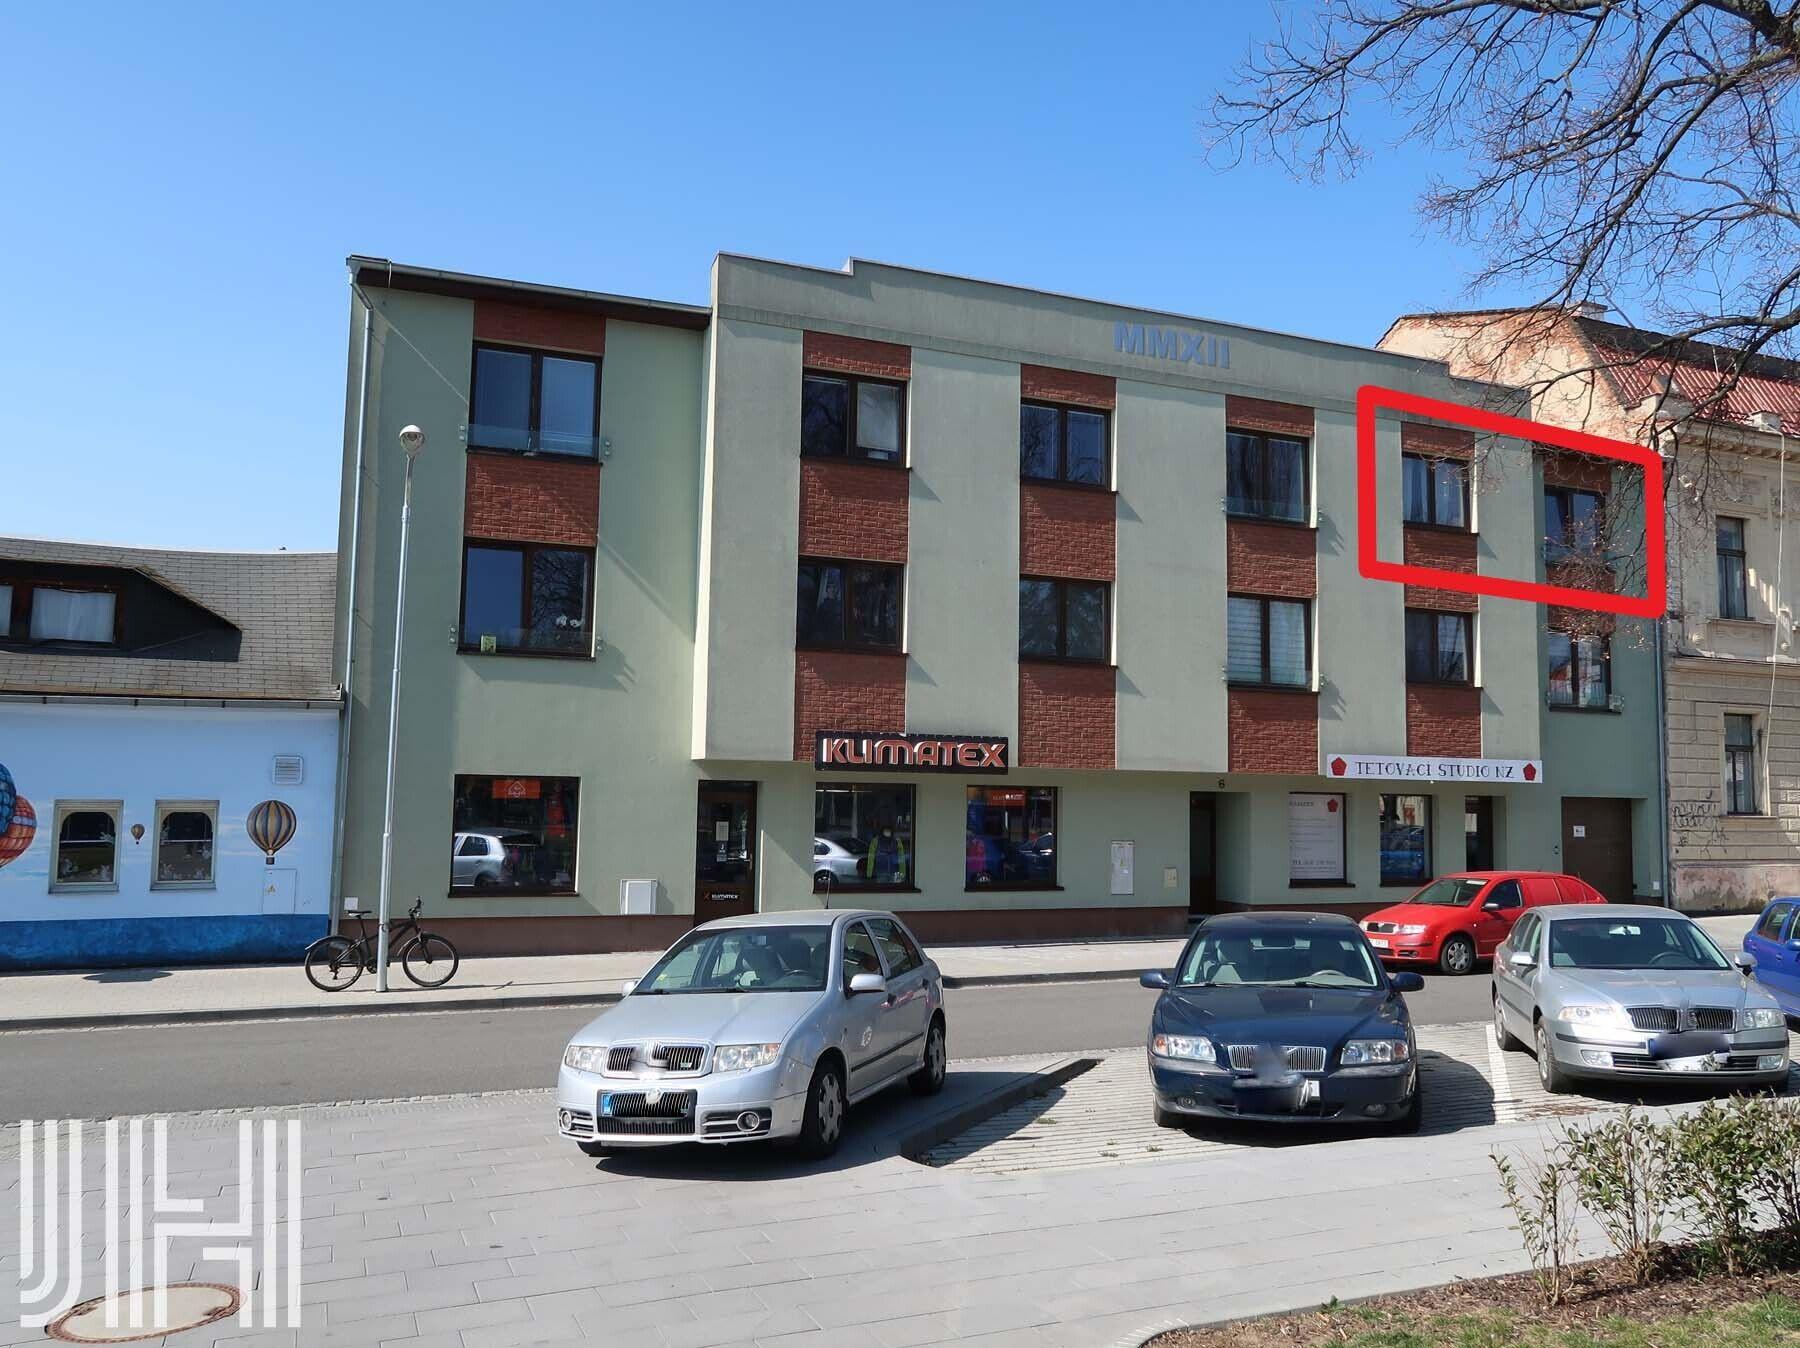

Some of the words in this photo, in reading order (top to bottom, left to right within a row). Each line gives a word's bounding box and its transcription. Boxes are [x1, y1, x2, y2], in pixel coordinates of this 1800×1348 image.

[1113, 320, 1230, 369] MMXII
[822, 737, 1006, 768] KLIMATEX
[1438, 763, 1490, 778] STUDIO
[1495, 766, 1515, 779] NZ
[1218, 779, 1225, 789] 6
